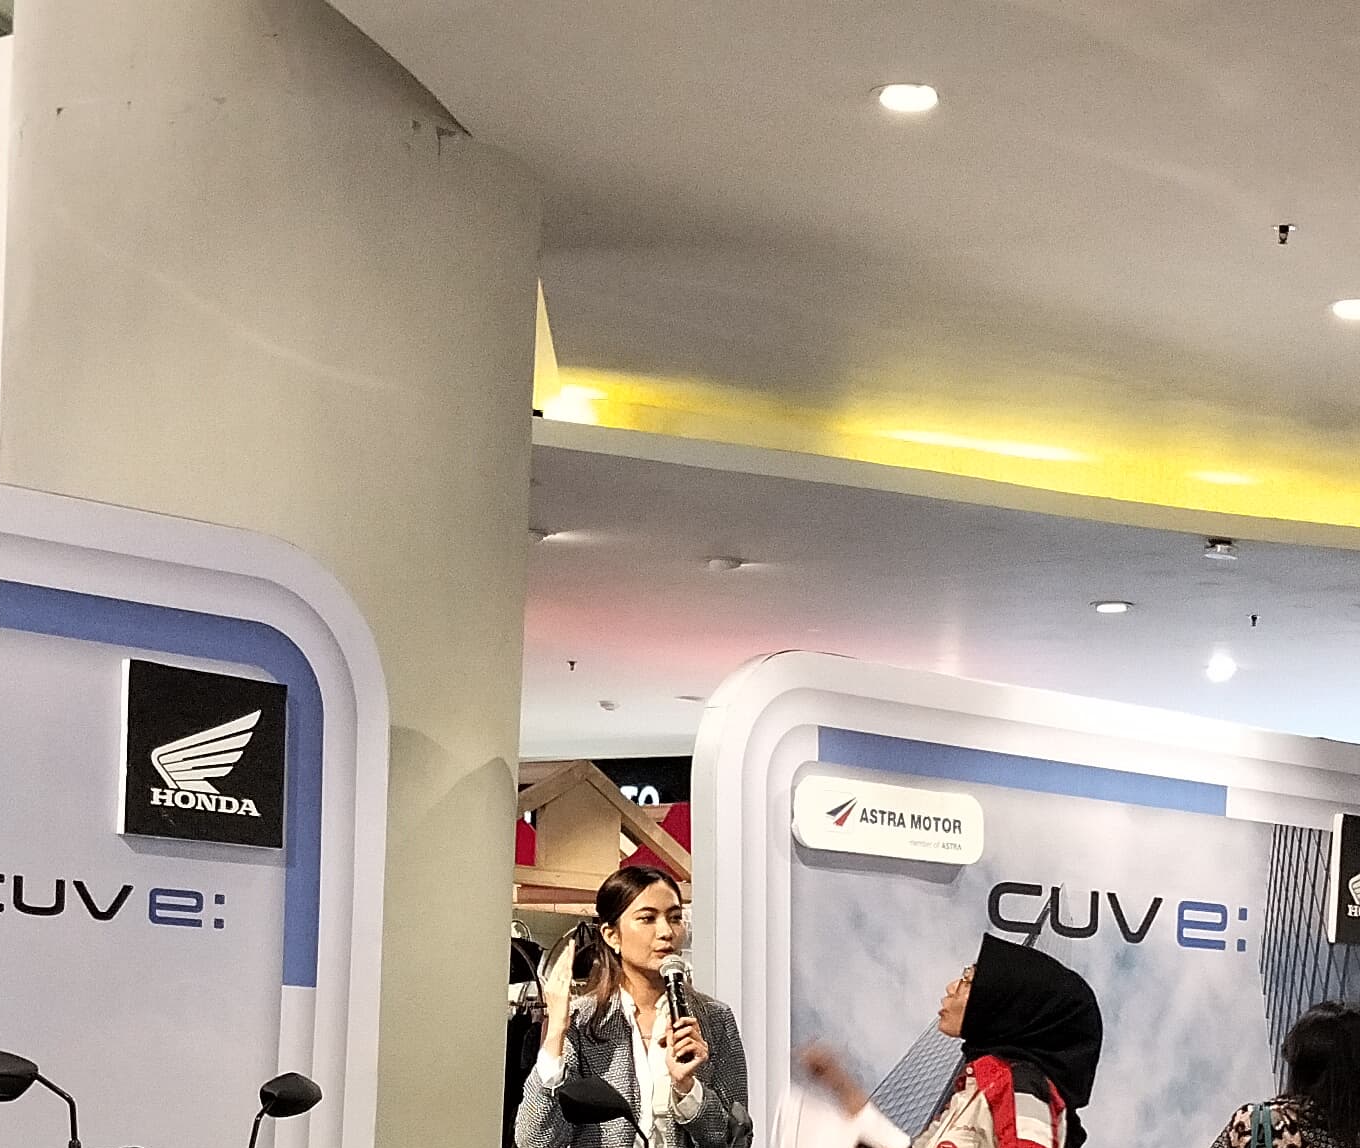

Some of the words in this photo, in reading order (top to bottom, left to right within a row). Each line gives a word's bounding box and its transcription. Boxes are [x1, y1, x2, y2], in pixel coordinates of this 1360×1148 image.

[150, 787, 262, 817] HONDA
[860, 807, 906, 828] ASTRA
[910, 813, 962, 834] MOTOR
[988, 881, 1163, 943] CUV
